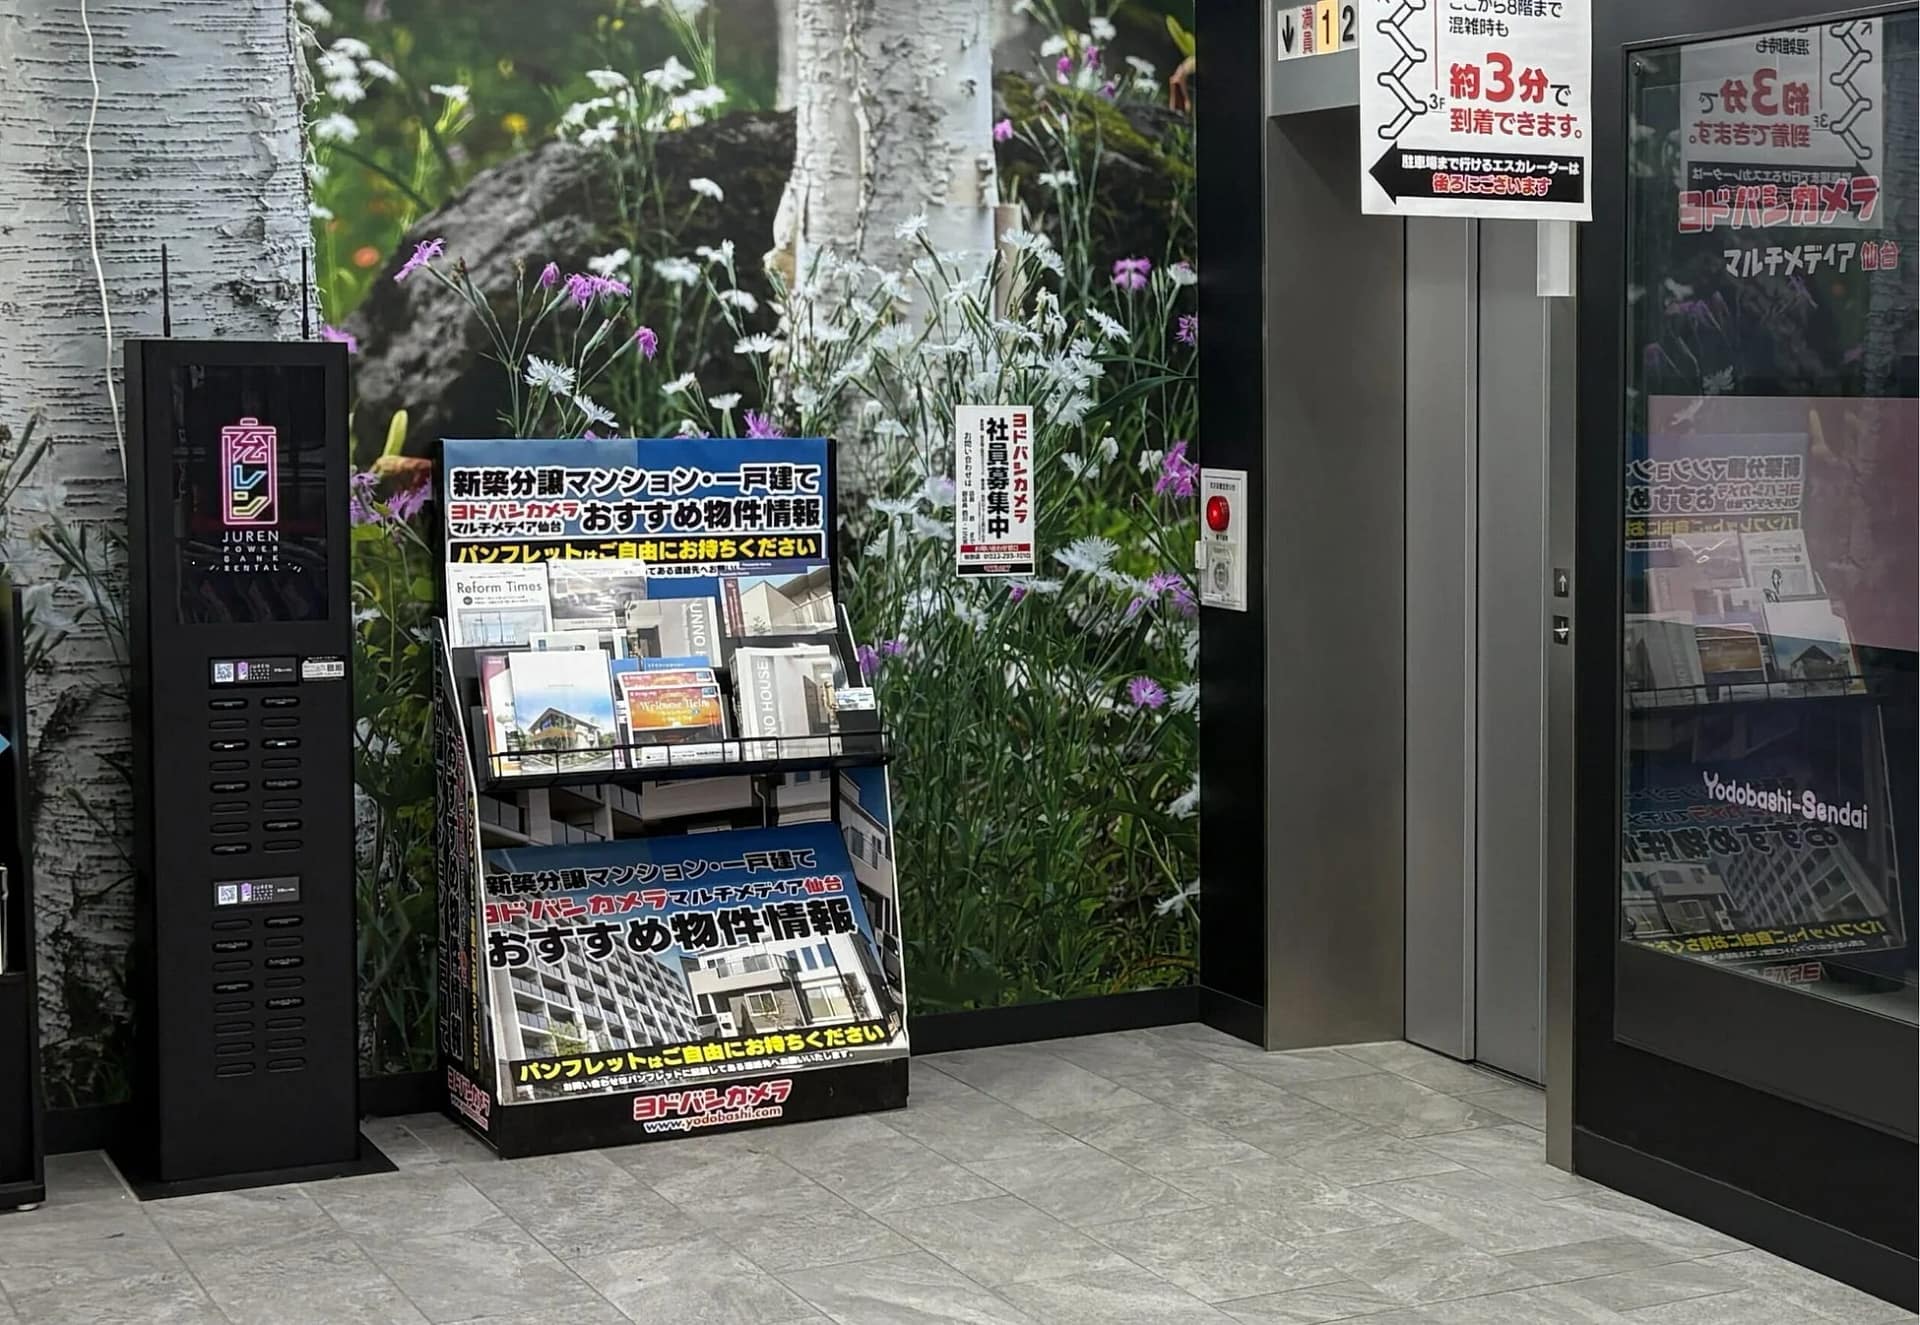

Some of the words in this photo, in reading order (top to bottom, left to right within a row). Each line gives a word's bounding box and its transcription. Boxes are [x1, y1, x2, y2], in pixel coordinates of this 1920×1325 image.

[1322, 9, 1330, 45] 1
[1342, 5, 1355, 42] 2
[1449, 16, 1510, 37] 混雑時も
[1450, 52, 1572, 107] 約3分で
[1429, 94, 1446, 110] 3F
[1450, 107, 1583, 139] 到着できます。
[1402, 154, 1580, 175] 駐車場まで行けるエスカレーターは
[1432, 172, 1552, 197] 後ろにございます
[1679, 175, 1880, 233] ヨドバシカメラ
[452, 465, 820, 497] 新築分譲マンション・一戸建て
[986, 417, 1010, 539] 社員募集中
[1013, 413, 1028, 524] ヨドバシカメラ
[450, 503, 580, 521] ヨドバシカメラ
[451, 521, 564, 535] マルチメディア仙台
[582, 498, 821, 532] おすすめ物件情報
[222, 530, 279, 543] JUREN
[223, 545, 279, 553] POWER
[457, 537, 818, 564] パンフレットはご自由にお持ちください
[223, 555, 279, 563] BANK
[223, 564, 280, 573] RENTAL
[457, 581, 502, 594] Reform
[506, 581, 543, 592] Times
[756, 658, 774, 713] HOUSE
[1703, 771, 1869, 830] Yodobashi-Sendai
[487, 895, 858, 969] おすすめ物件情報
[520, 1024, 886, 1082] パンフレットはご自由にお持ちください
[633, 1078, 794, 1121] ヨドバシカメラ
[643, 1106, 783, 1133] www.yodobashi.com
